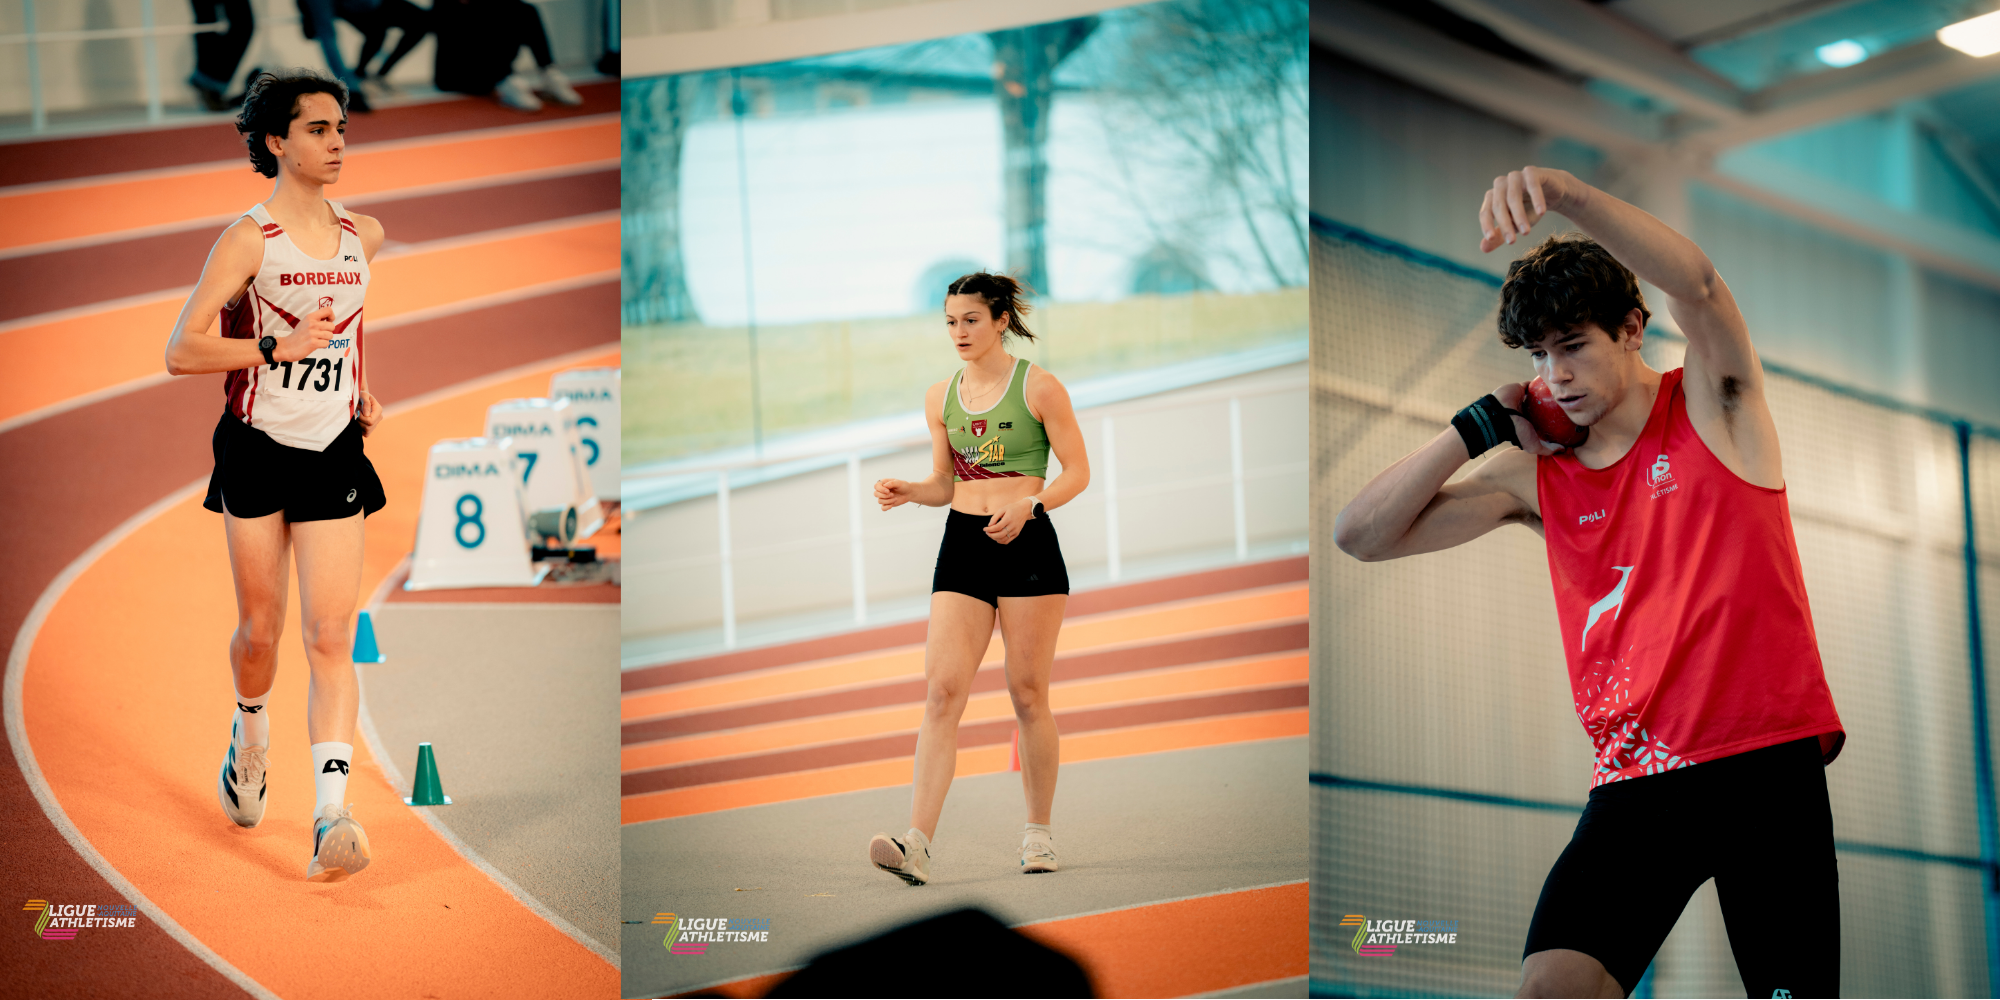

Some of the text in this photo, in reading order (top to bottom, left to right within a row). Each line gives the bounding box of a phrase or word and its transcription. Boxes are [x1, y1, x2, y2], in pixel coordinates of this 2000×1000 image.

[280, 272, 362, 286] BORDEAUX
[323, 338, 350, 349] PORT
[280, 357, 343, 392] 1731
[435, 463, 499, 479] DIMA
[517, 452, 538, 487] 7
[454, 493, 486, 549] 8
